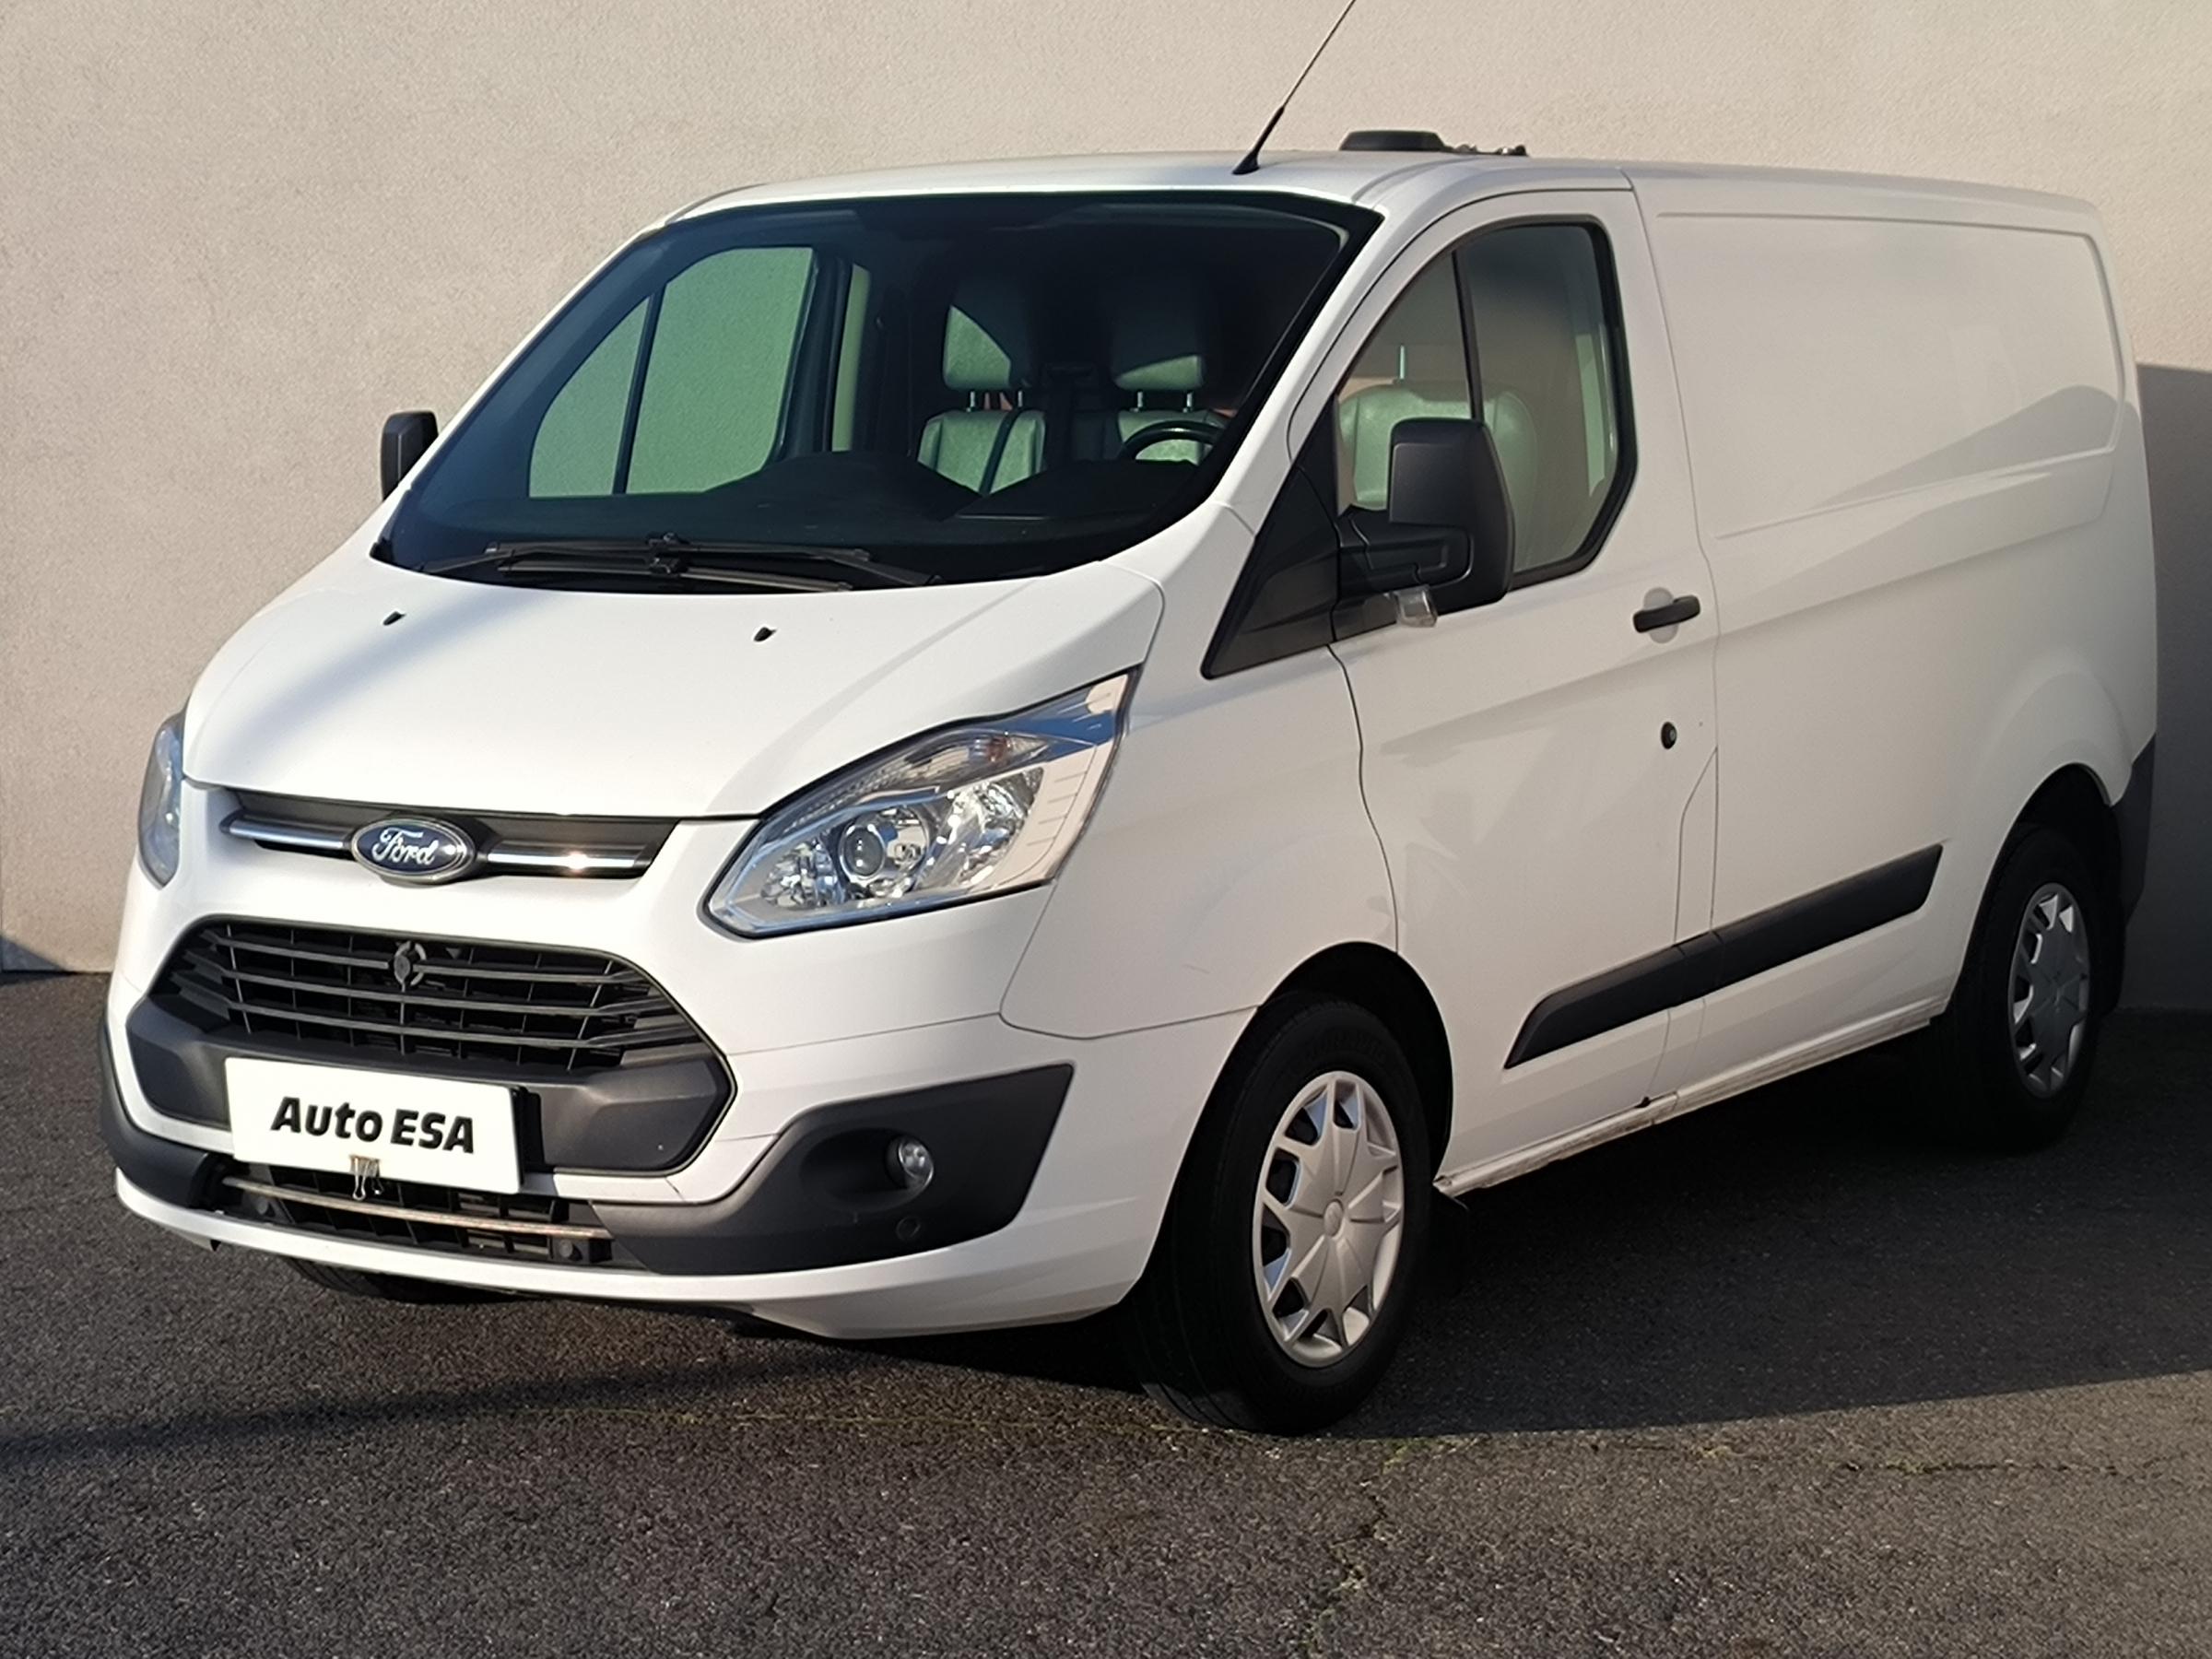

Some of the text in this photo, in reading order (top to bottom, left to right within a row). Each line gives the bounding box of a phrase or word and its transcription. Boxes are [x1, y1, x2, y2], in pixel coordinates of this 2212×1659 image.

[371, 827, 440, 865] Ford
[270, 1096, 475, 1154] Auto ESA
